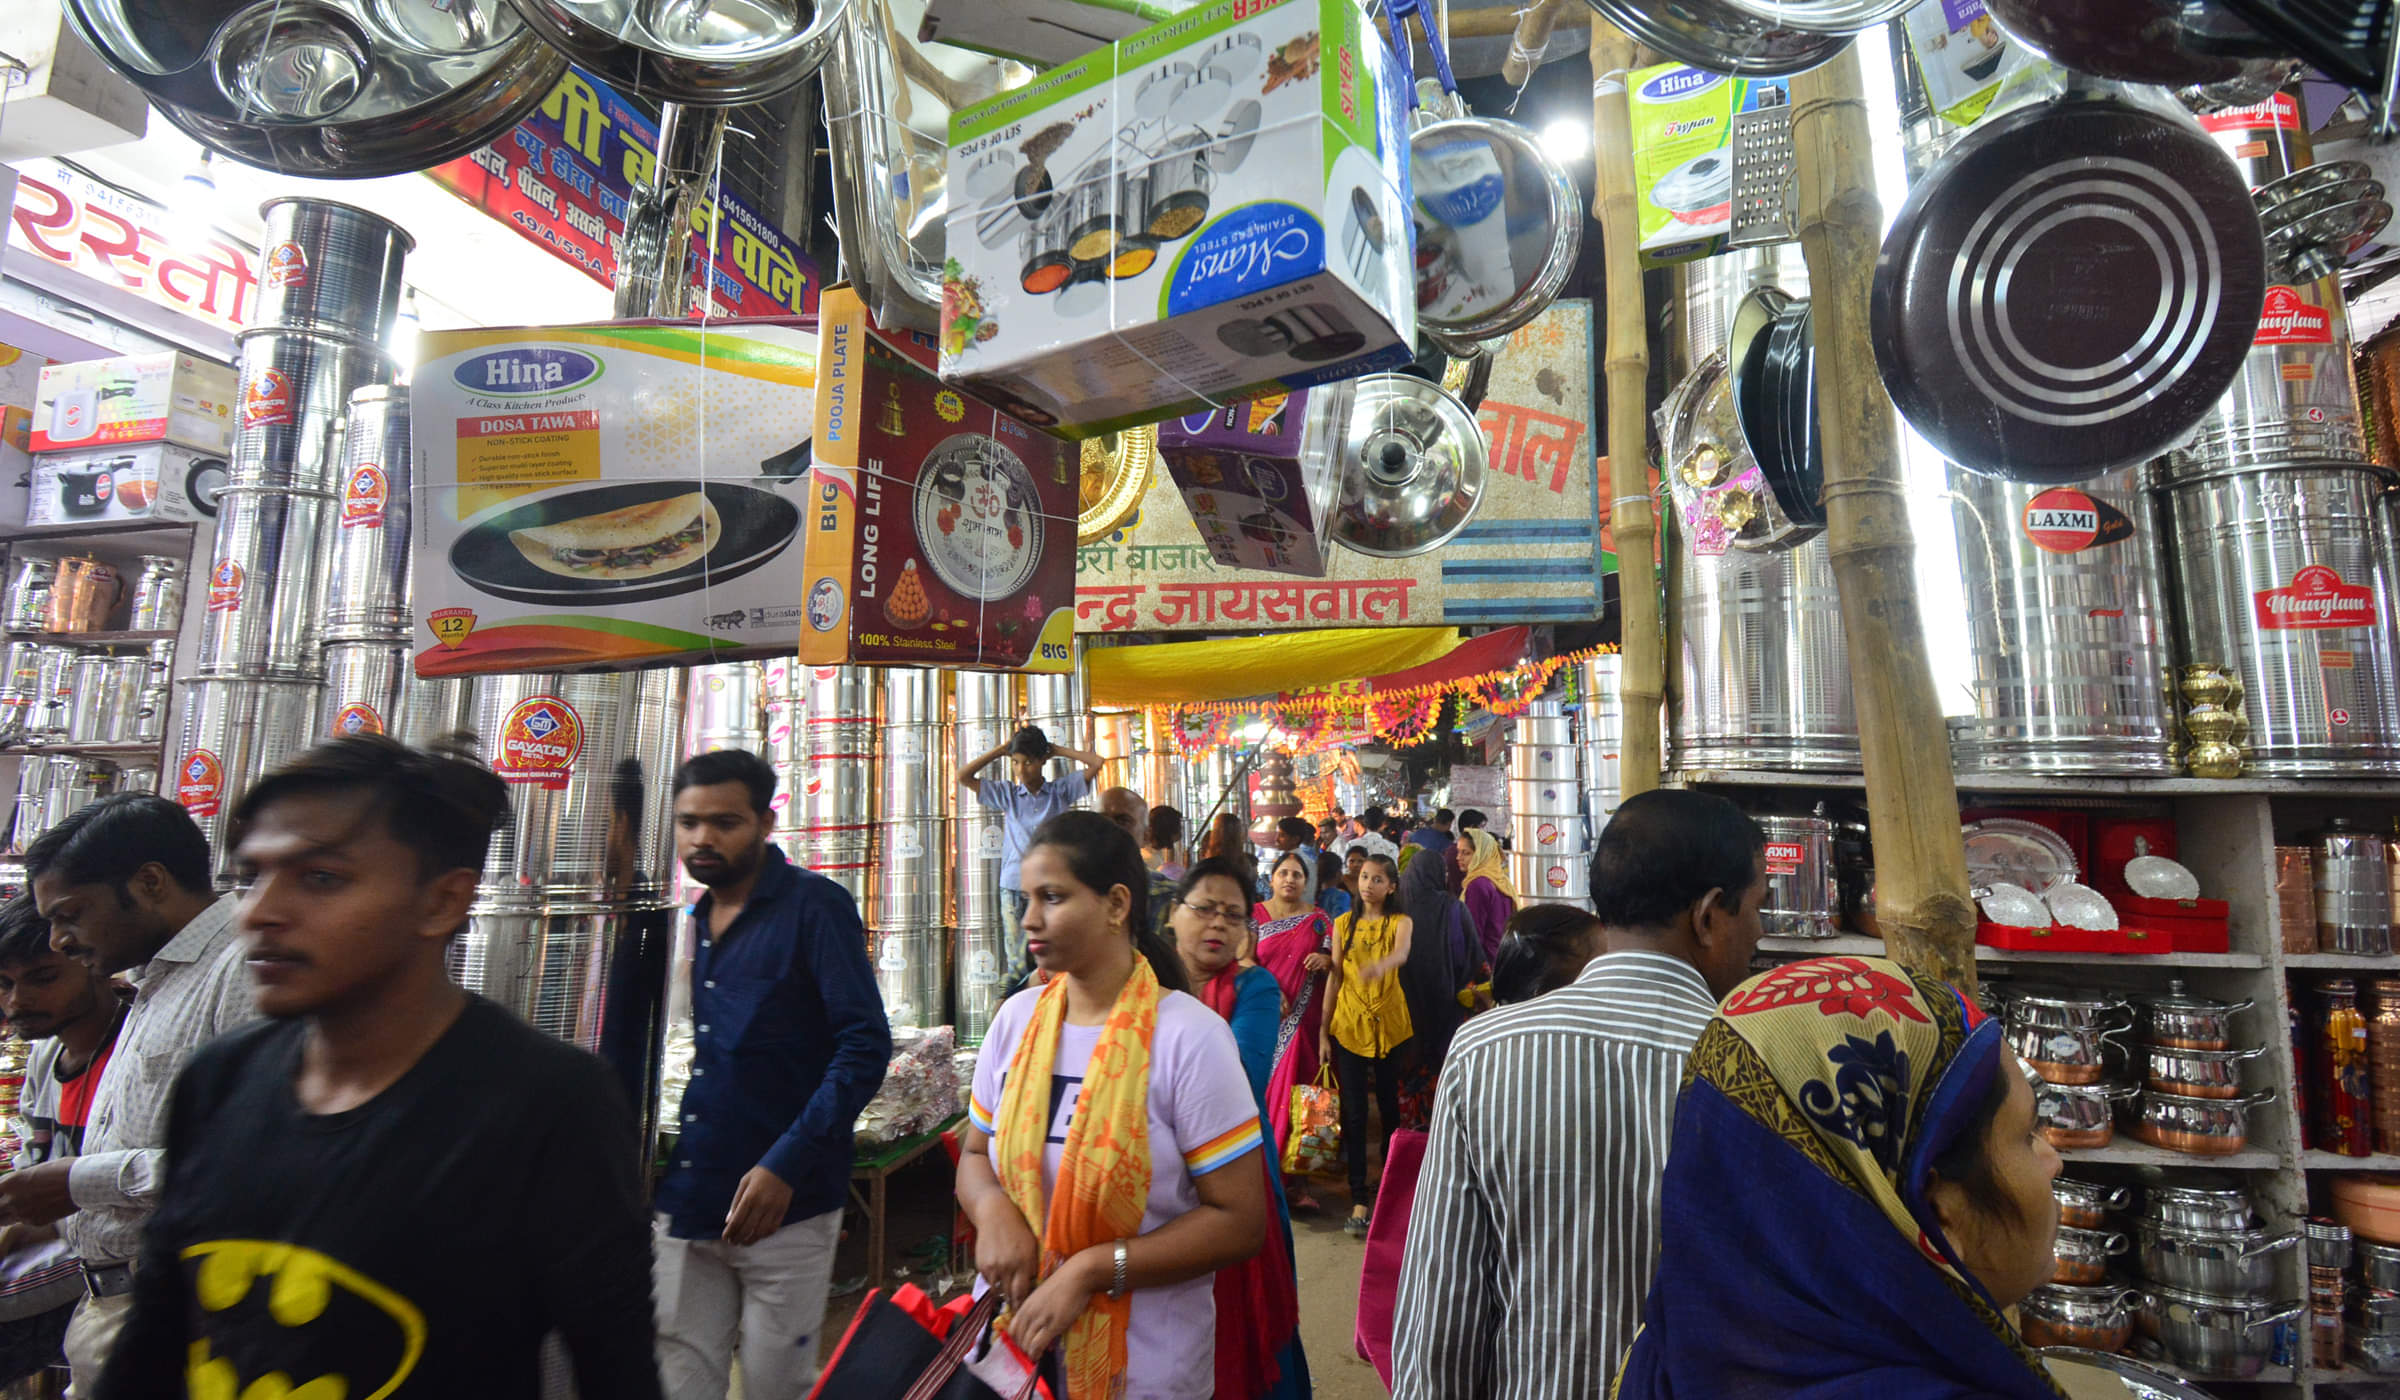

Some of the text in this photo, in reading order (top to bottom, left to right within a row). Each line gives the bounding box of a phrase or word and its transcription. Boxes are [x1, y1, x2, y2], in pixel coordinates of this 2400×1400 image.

[1340, 45, 1354, 121] SIXER
[1659, 71, 1704, 96] Hina
[987, 129, 1002, 147] OF
[1002, 123, 1022, 143] SET
[722, 194, 778, 248] 9415631800
[1188, 226, 1311, 284] Mansi
[1194, 236, 1232, 255] STEEL
[730, 218, 806, 315] वाले
[486, 359, 563, 386] Hina
[827, 323, 849, 441] POOJA PLATE
[476, 398, 501, 410] Class
[504, 400, 542, 410] Kitchen
[544, 393, 586, 408] Products
[938, 402, 961, 417] Pack
[480, 415, 576, 434] DOSA TAWA
[535, 434, 570, 444] COATING
[820, 482, 838, 532] BIG
[859, 457, 884, 598] LONG LIFE
[2030, 512, 2095, 528] LAXMI
[1153, 578, 1418, 625] जायसवाल
[2265, 592, 2366, 618] Manglam
[442, 618, 464, 632] 12
[858, 632, 957, 651] 100% Stainless Steel
[1041, 643, 1068, 659] BIG
[507, 739, 568, 758] GAYATRI
